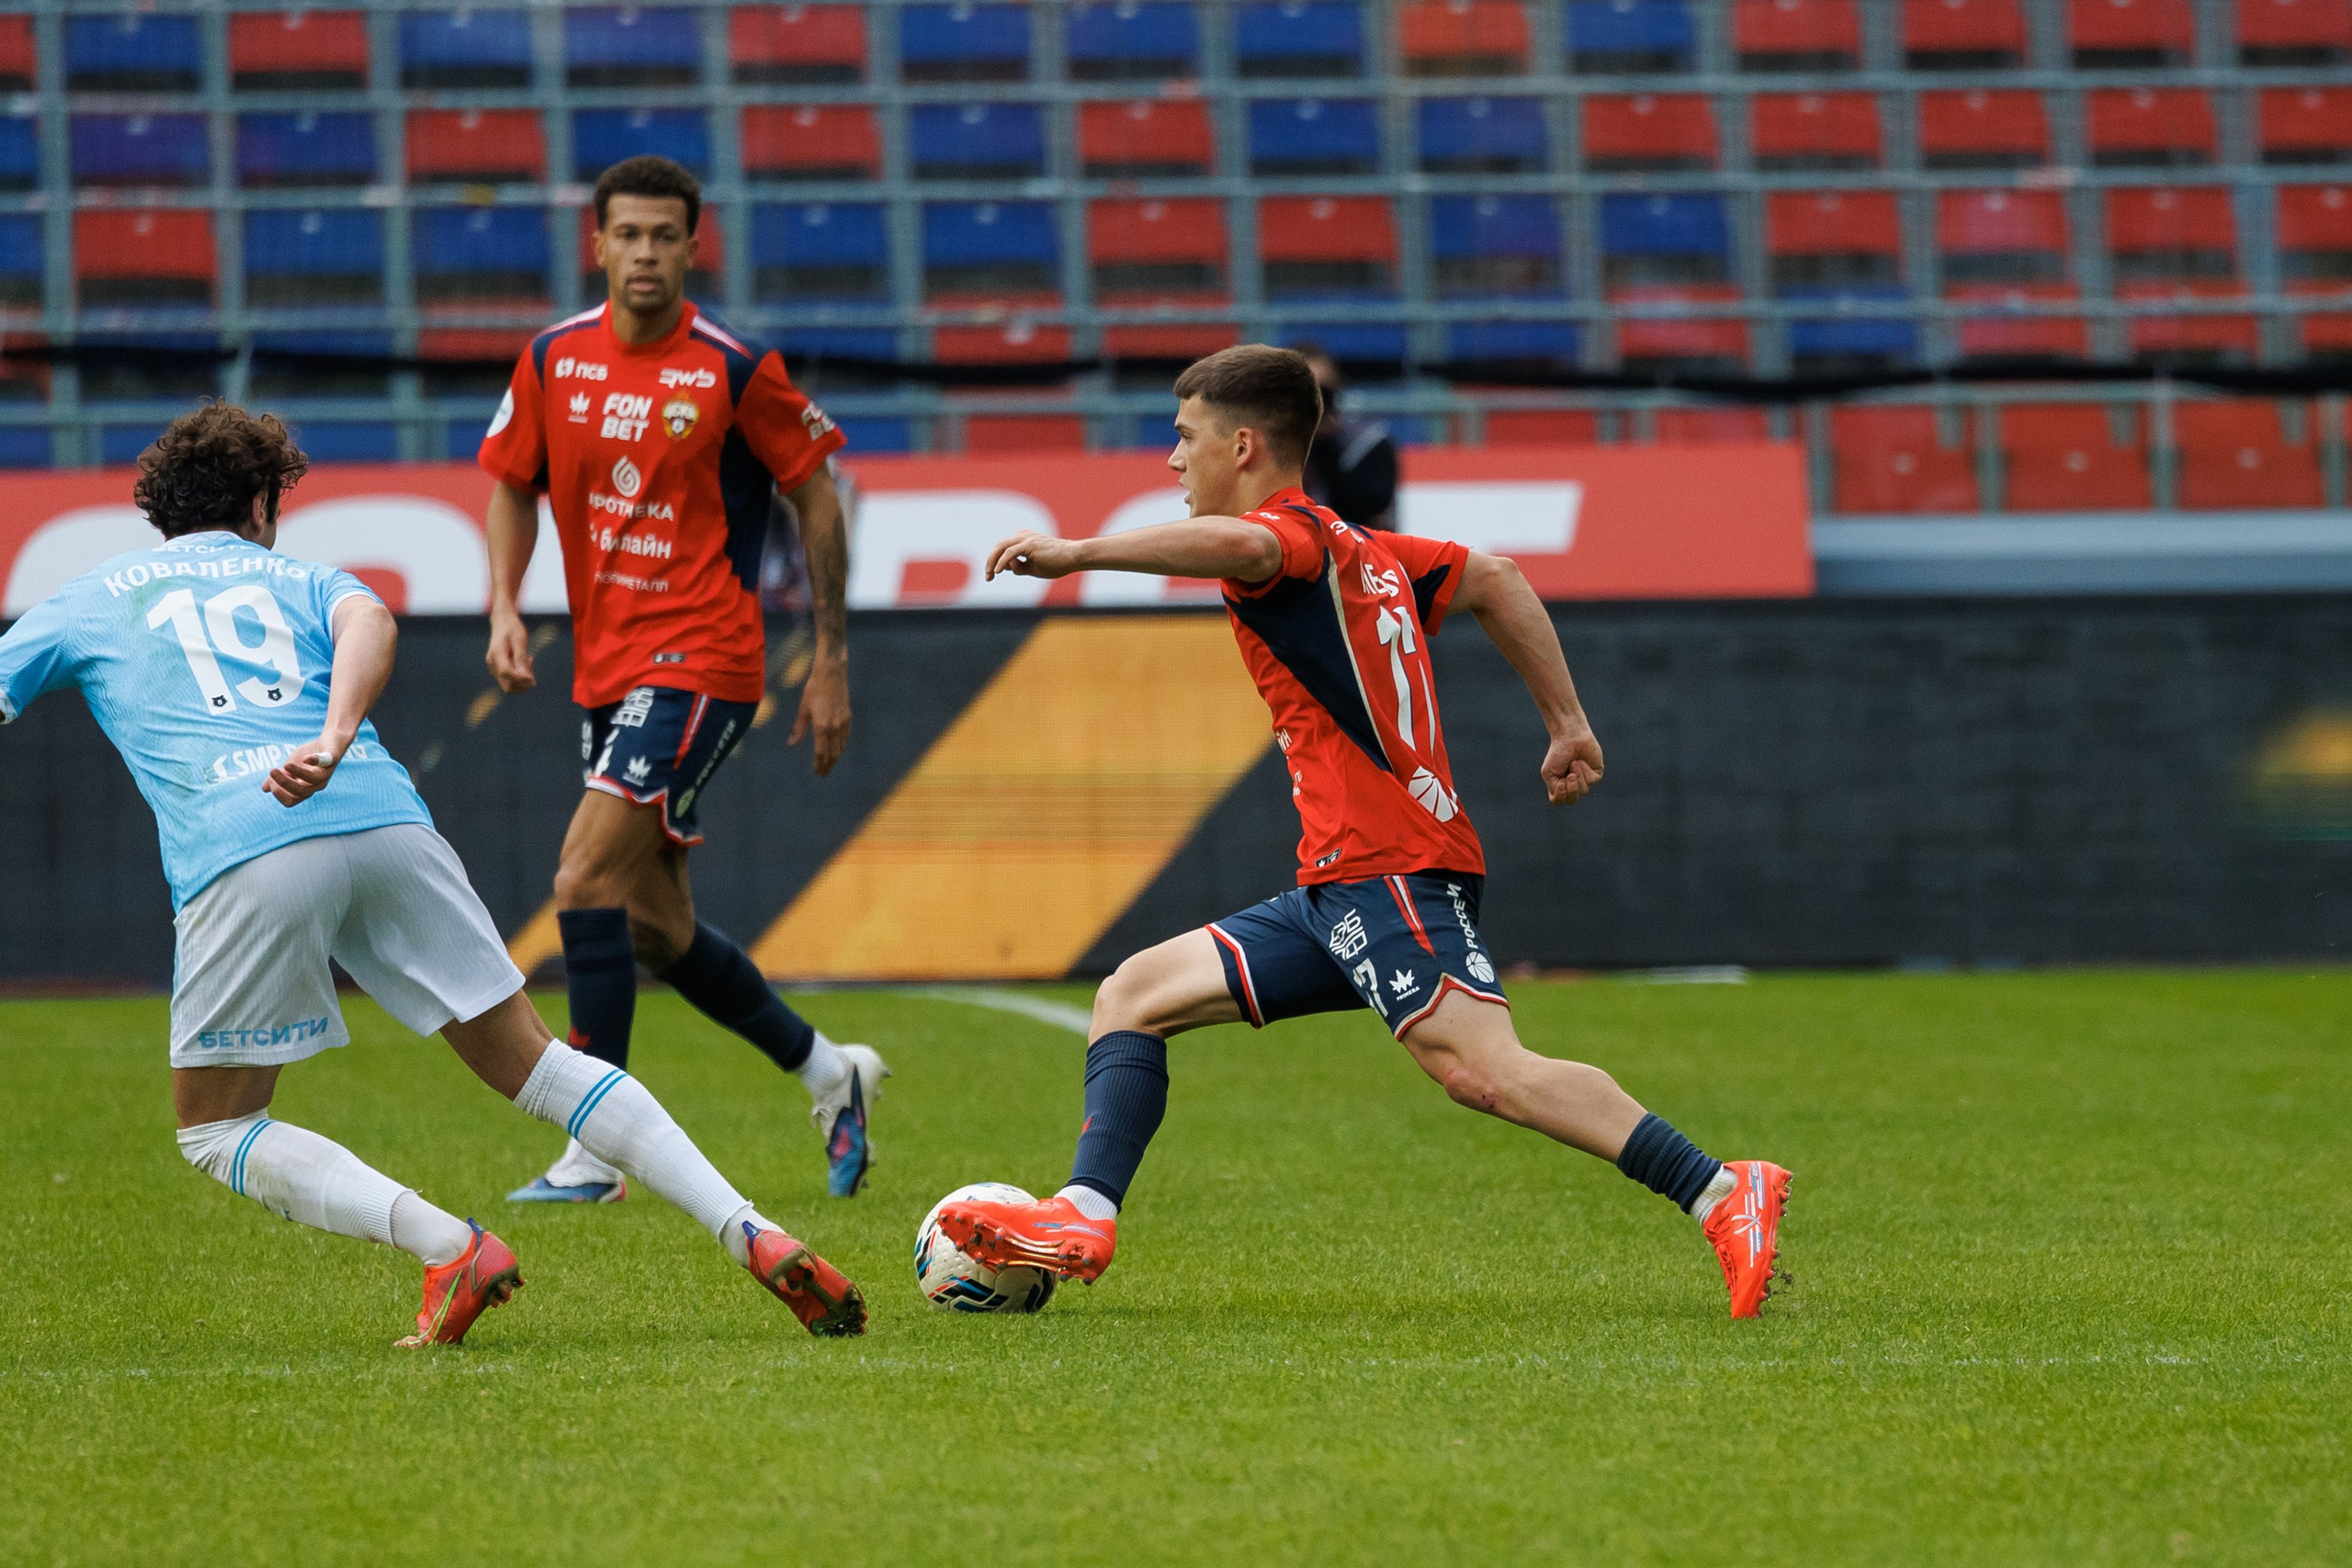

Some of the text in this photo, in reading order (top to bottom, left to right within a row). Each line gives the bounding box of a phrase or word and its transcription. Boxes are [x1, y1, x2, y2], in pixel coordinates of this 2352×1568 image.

[603, 392, 653, 418] FON
[600, 415, 650, 442] BET
[103, 557, 308, 598] КОВАЛЕНКО
[146, 585, 306, 716] 19
[232, 744, 281, 776] SMP
[1446, 883, 1478, 949] РОССЕИ
[198, 1017, 329, 1048] БЕТСИТИ
